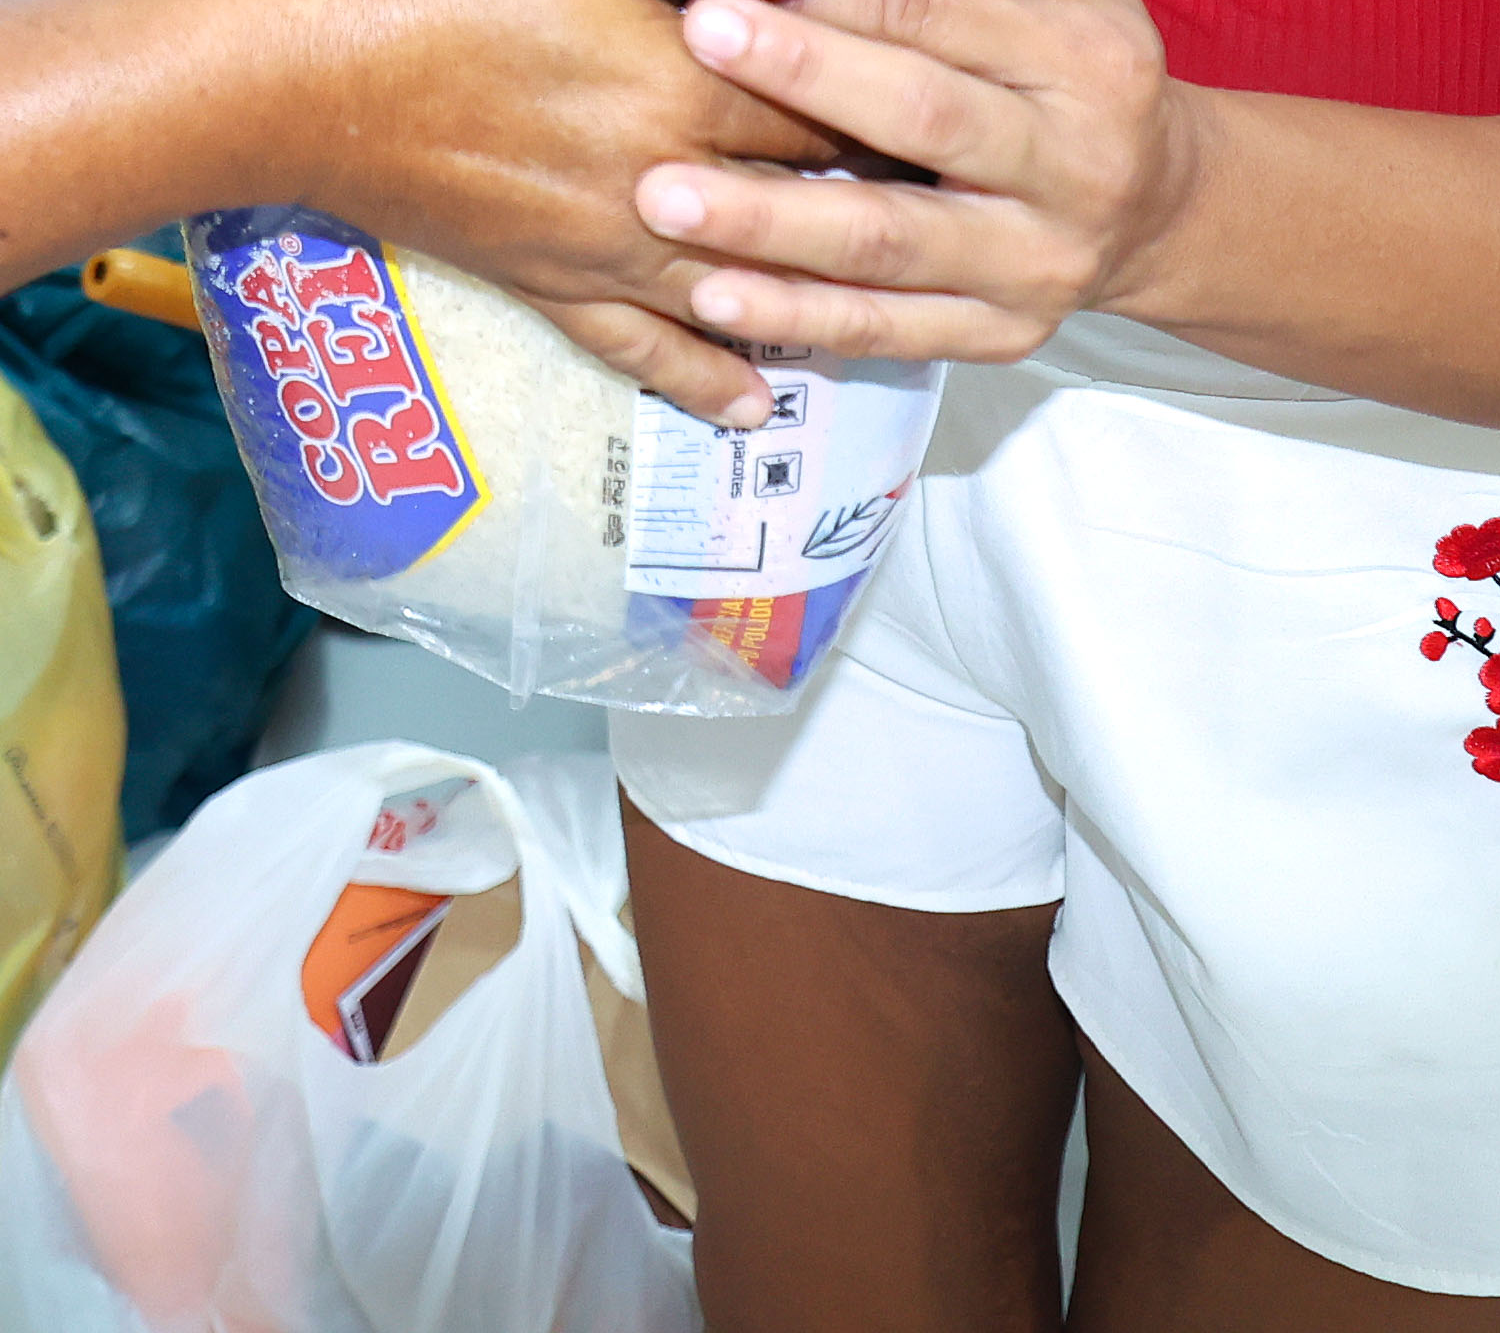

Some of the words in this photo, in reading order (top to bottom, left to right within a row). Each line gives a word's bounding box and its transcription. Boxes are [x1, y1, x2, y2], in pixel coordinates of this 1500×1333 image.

[236, 250, 363, 505] COPA
[281, 247, 465, 506] REI
[729, 440, 747, 500] pacotes
